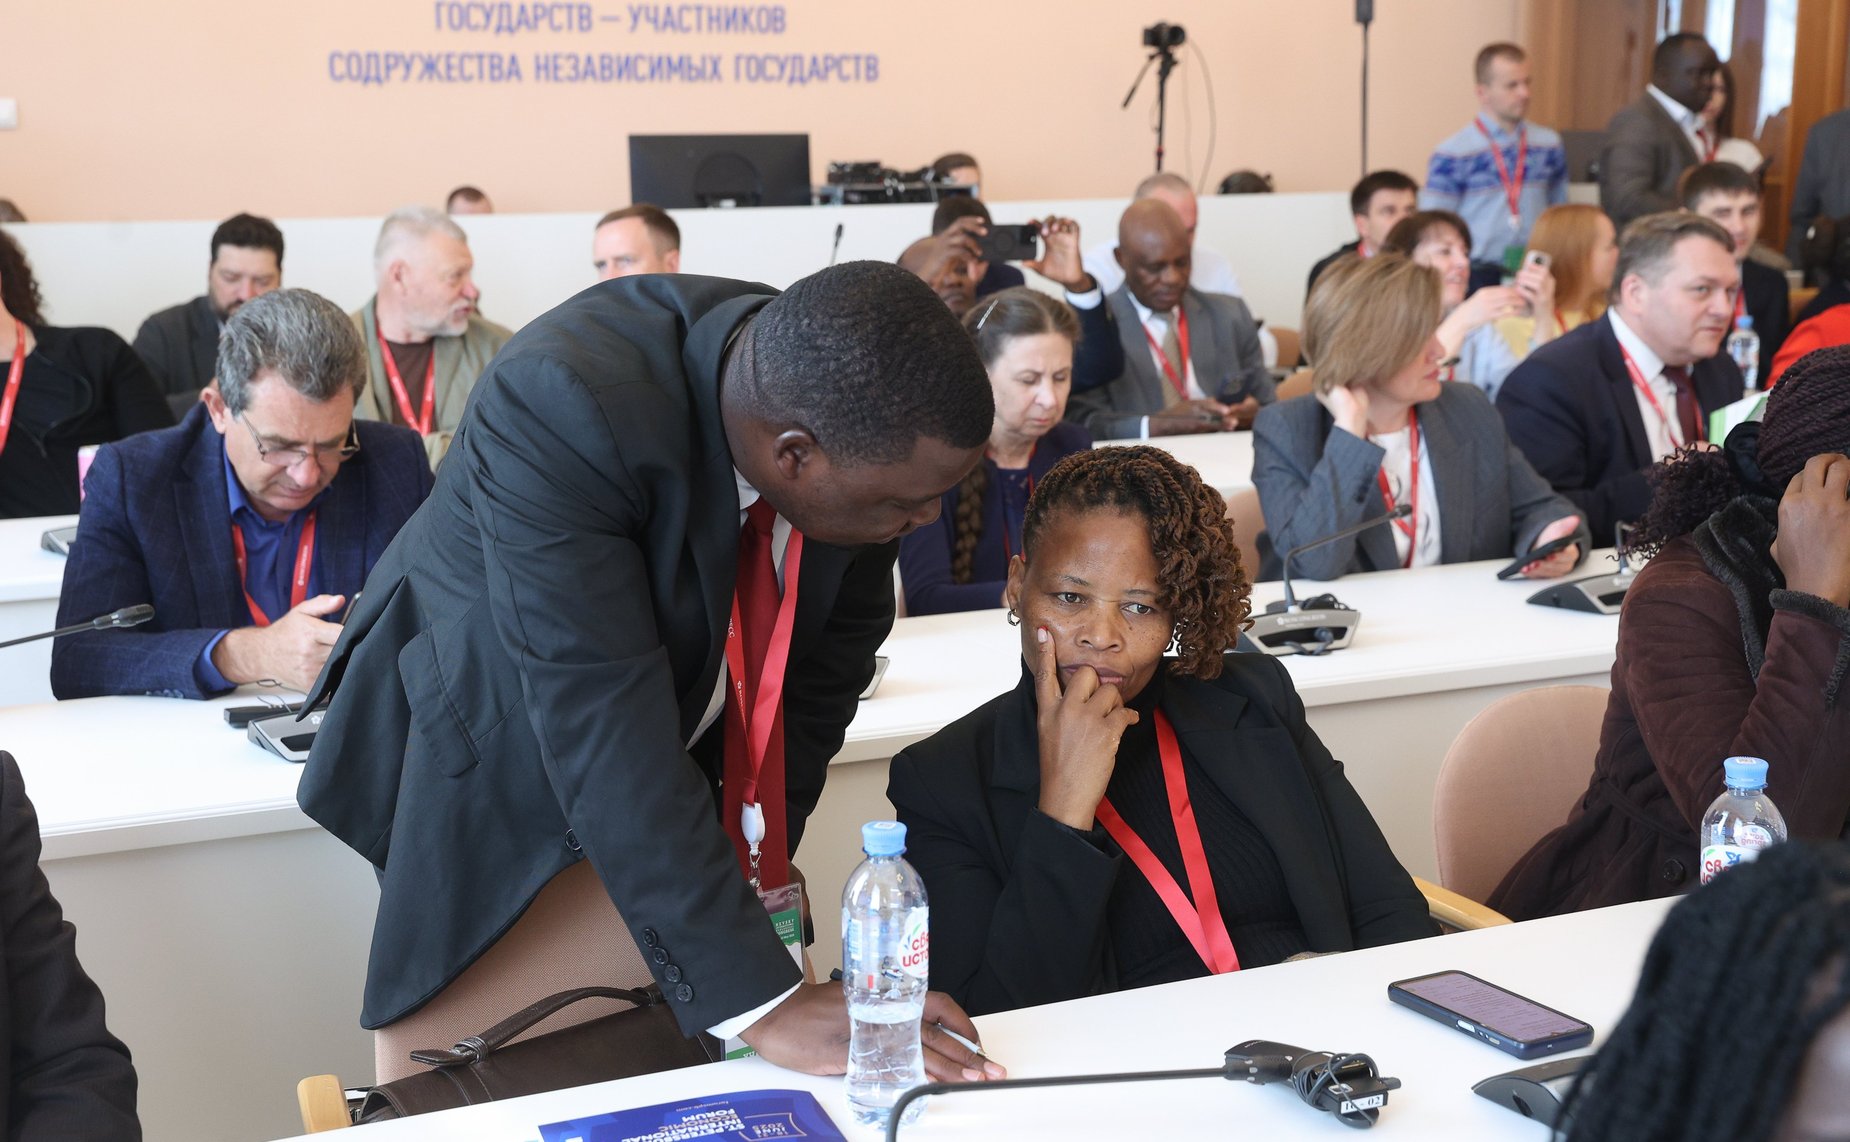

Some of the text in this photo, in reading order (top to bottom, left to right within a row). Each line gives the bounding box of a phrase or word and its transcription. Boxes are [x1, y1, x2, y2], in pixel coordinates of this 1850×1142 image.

[435, 0, 593, 35] ГОСУДАРСТВ
[628, 3, 786, 34] УЧАСТНИКОВ
[328, 50, 879, 86] СОДРУЖЕСТВА НЕЗАВИСИМЫХ ГОСУДАРСТВ
[658, 1113, 738, 1132] ECONOMIC
[682, 1108, 735, 1122] FORUM
